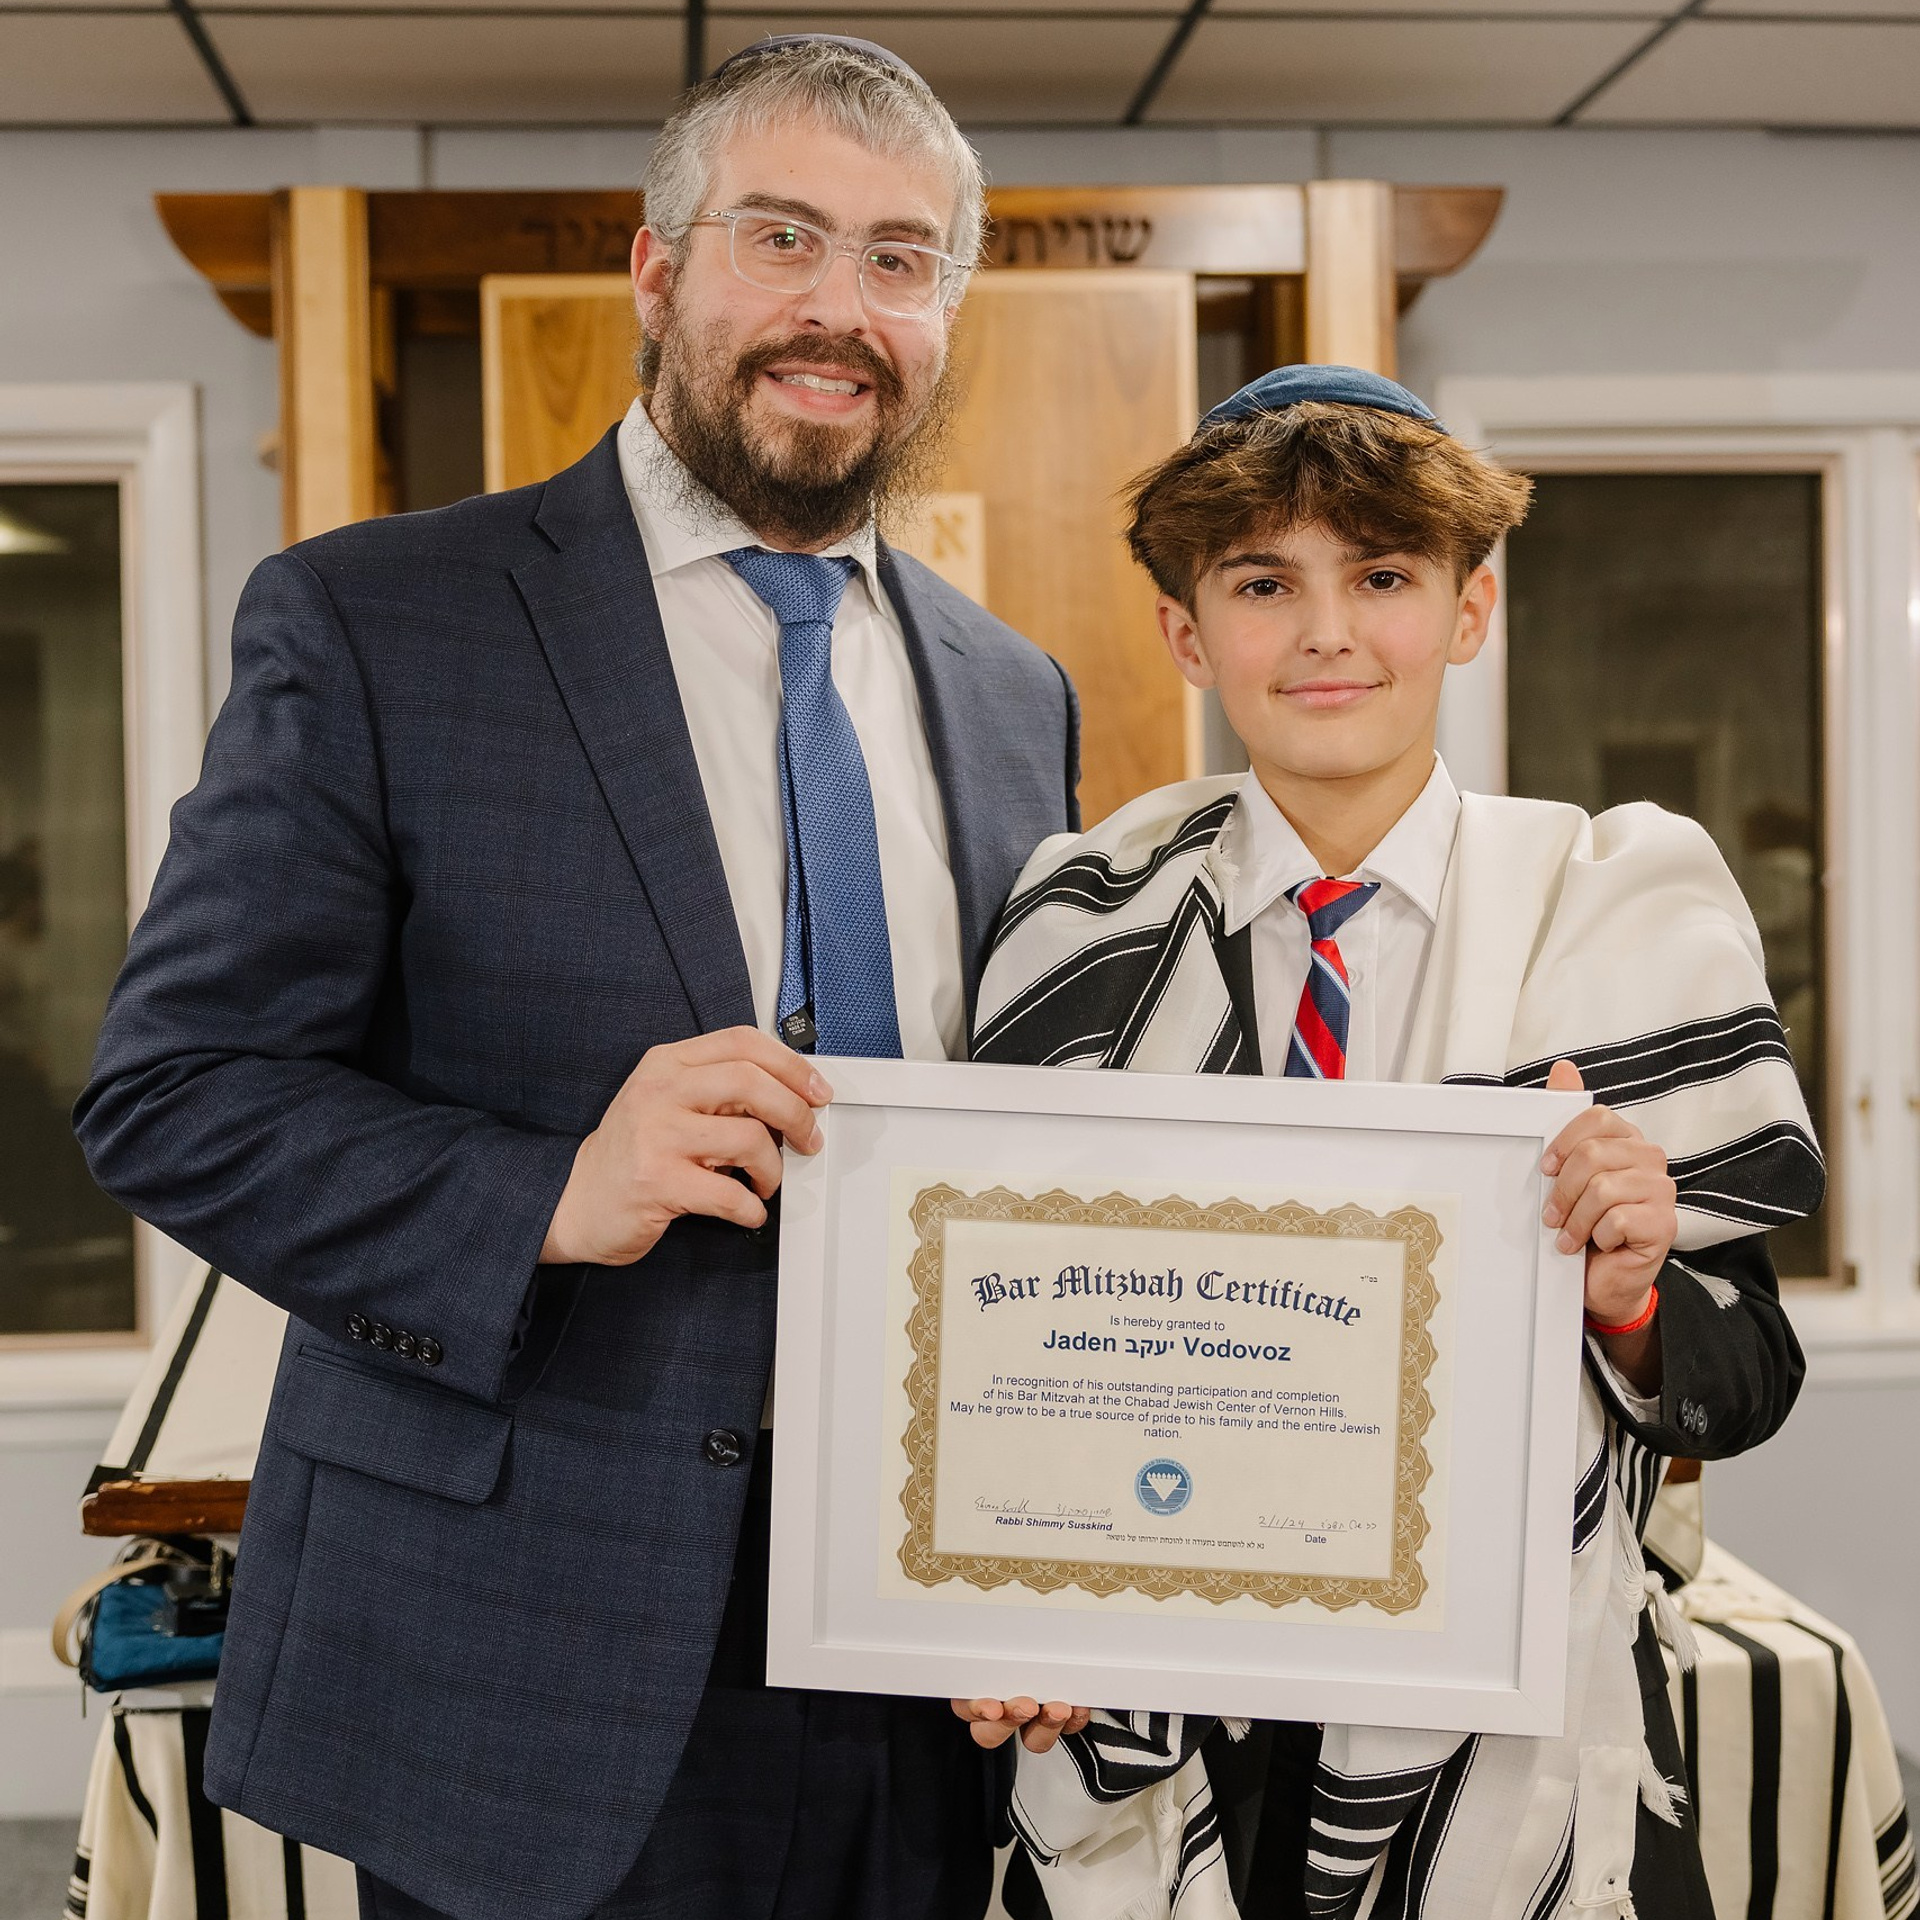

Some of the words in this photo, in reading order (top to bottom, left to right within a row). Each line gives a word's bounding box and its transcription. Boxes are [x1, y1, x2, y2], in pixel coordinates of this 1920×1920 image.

[971, 1272, 1041, 1313] Bar
[1052, 1265, 1184, 1303] Mitzvah
[1196, 1270, 1361, 1327] Certificate
[1110, 1315, 1120, 1326] Is
[1123, 1316, 1163, 1330] hereby
[1166, 1319, 1211, 1331] granted
[1214, 1321, 1225, 1331] to
[1043, 1330, 1117, 1352] Jaden
[1124, 1338, 1175, 1358] יעקב
[1183, 1337, 1291, 1361] Vodovoz
[992, 1374, 1003, 1385] In
[1006, 1376, 1069, 1389] recognition
[1072, 1379, 1084, 1389] of
[1087, 1380, 1104, 1390] his
[1107, 1382, 1174, 1395] outstanding
[1177, 1386, 1248, 1399] participation
[1250, 1389, 1273, 1399] and
[1276, 1391, 1340, 1403] completion
[983, 1390, 994, 1399] of
[997, 1389, 1014, 1400] his
[1017, 1391, 1037, 1401] Bar
[1041, 1392, 1085, 1404] Mitzvah
[1088, 1396, 1100, 1405] at
[1103, 1395, 1121, 1406] the
[1124, 1396, 1169, 1408] Chabad
[1173, 1399, 1213, 1411] Jewish
[1216, 1401, 1256, 1413] Center
[1259, 1404, 1270, 1414] of
[1273, 1404, 1316, 1416] Vernon
[1319, 1407, 1347, 1418] Hills.
[950, 1402, 974, 1414] May
[978, 1403, 992, 1413] he
[995, 1405, 1024, 1416] grow
[1027, 1406, 1038, 1416] to
[1041, 1406, 1056, 1417] be
[1059, 1409, 1066, 1418] a
[1070, 1408, 1092, 1419] true
[1096, 1411, 1135, 1421] source
[1138, 1412, 1149, 1422] of
[1152, 1413, 1181, 1425] pride
[1184, 1415, 1196, 1425] to
[1199, 1415, 1216, 1426] his
[1219, 1416, 1253, 1430] family
[1256, 1419, 1279, 1429] and
[1282, 1420, 1300, 1430] the
[1304, 1422, 1337, 1432] entire
[1340, 1423, 1381, 1435] Jewish
[1143, 1427, 1182, 1439] nation.
[996, 1516, 1023, 1526] Rabbi
[1026, 1518, 1065, 1530] Shimmy
[1067, 1520, 1113, 1531] Susskind
[1304, 1534, 1327, 1544] Date
